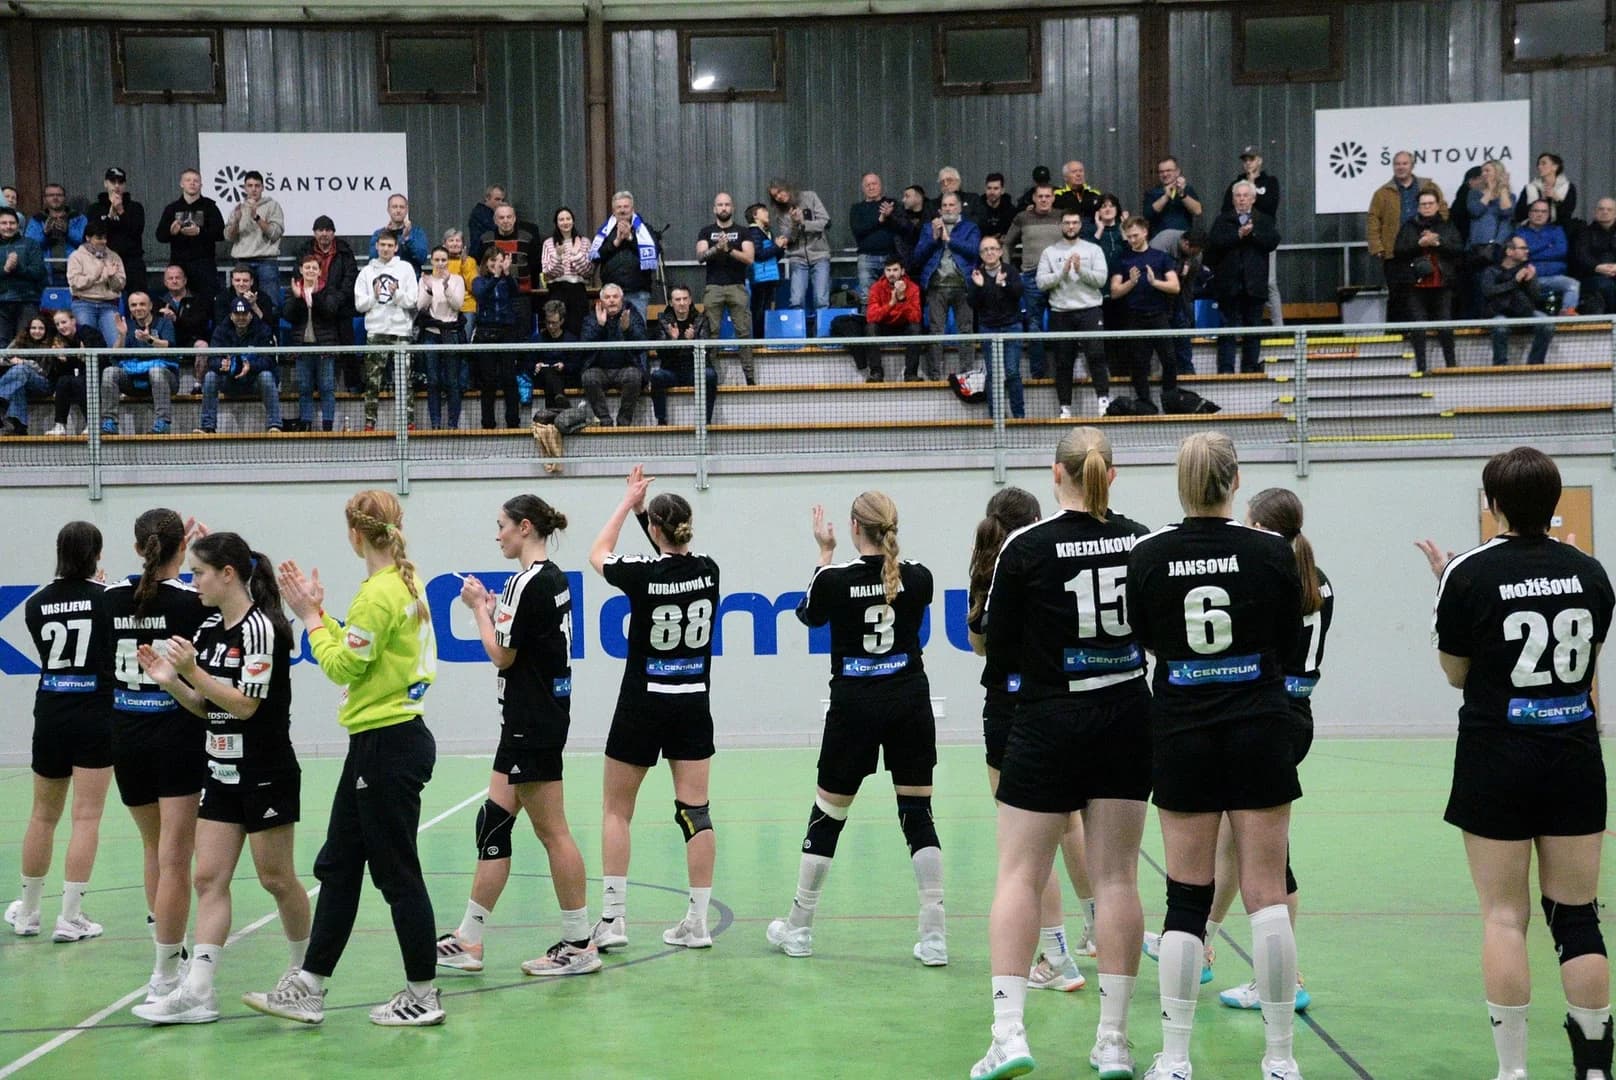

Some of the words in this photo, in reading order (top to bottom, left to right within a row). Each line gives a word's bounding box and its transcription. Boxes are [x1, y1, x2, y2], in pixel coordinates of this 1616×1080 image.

[1380, 145, 1513, 166] ŠNTOVKA
[265, 172, 392, 191] ŠANTOVKA
[1168, 554, 1239, 577] JANSOVÁ
[648, 575, 705, 595] KUBÁLKOVÁ
[1064, 565, 1132, 638] 15
[1499, 574, 1583, 600] MOŽÍŠOVÁ
[41, 600, 92, 615] VASILJEVA
[650, 598, 713, 651] 88
[1184, 585, 1233, 654] 6
[41, 619, 93, 670] 27
[863, 604, 896, 654] 3
[1503, 608, 1594, 688] 28
